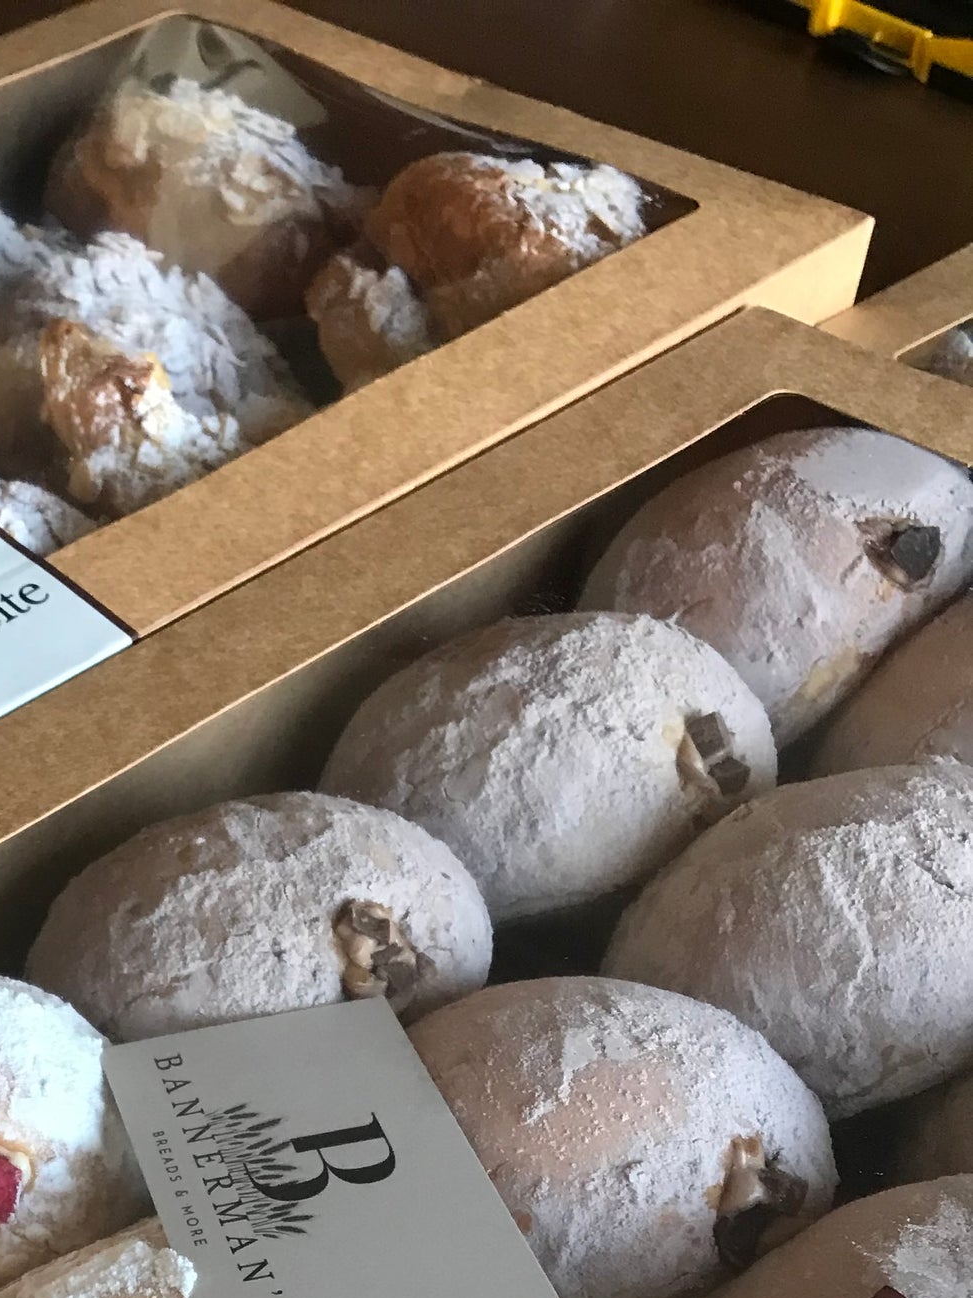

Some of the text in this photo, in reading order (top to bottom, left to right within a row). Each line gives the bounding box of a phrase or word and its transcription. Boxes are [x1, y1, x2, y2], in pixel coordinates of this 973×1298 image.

[152, 1130, 208, 1247] BREADS & MORE
[243, 1112, 397, 1201] B
